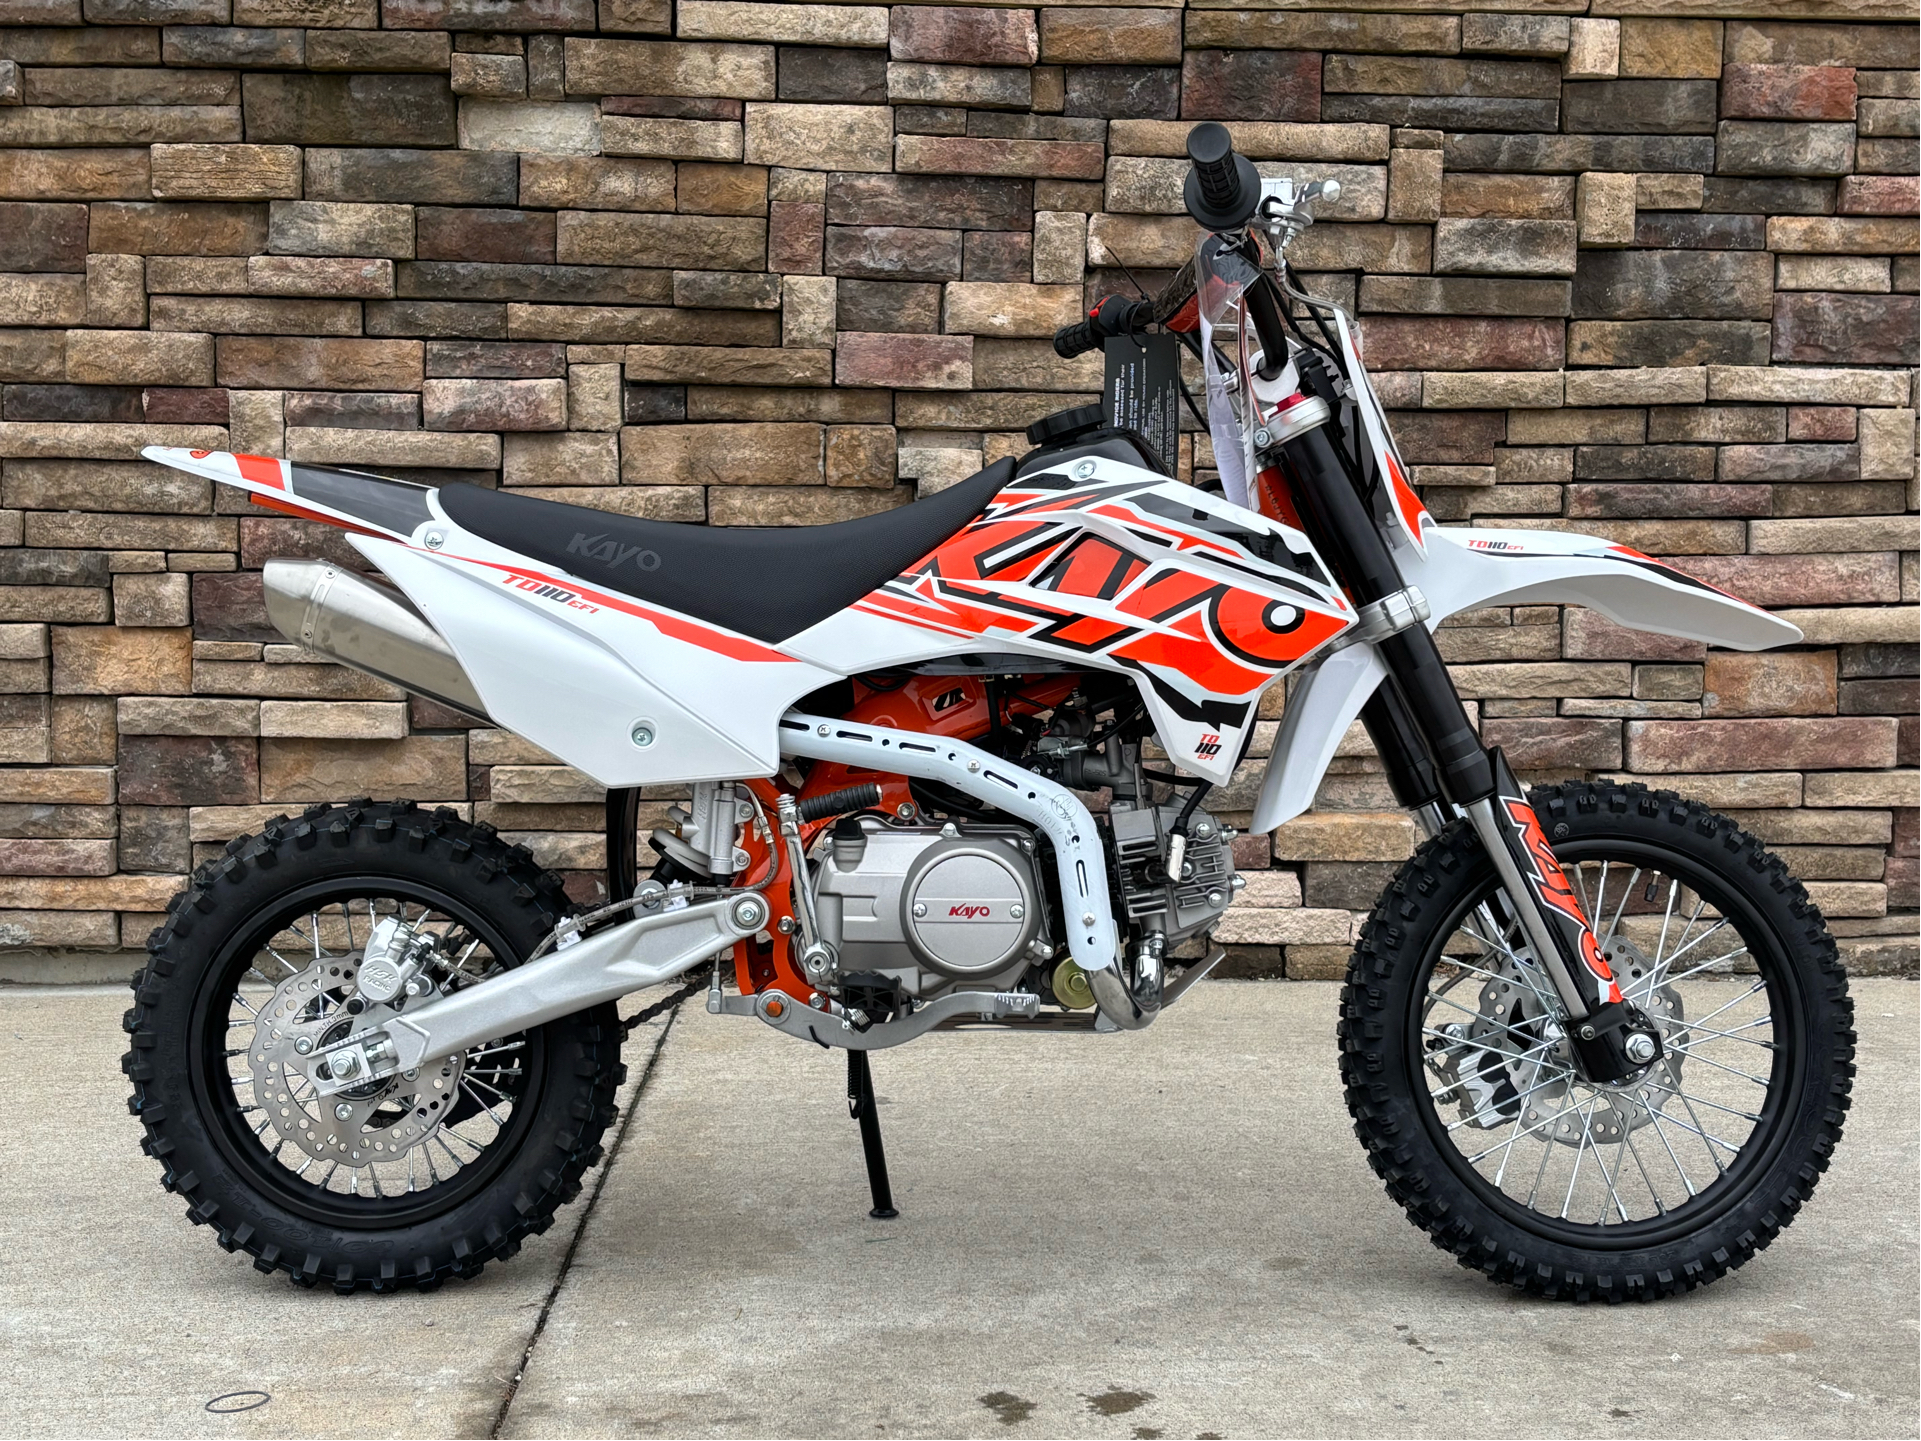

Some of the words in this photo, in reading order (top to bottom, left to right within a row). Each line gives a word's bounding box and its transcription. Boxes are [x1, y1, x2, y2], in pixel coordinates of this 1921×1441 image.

[565, 532, 662, 572] KAYO
[1200, 733, 1220, 744] TD
[1194, 742, 1222, 755] 110
[948, 902, 990, 919] KAYO
[362, 976, 392, 994] RACING
